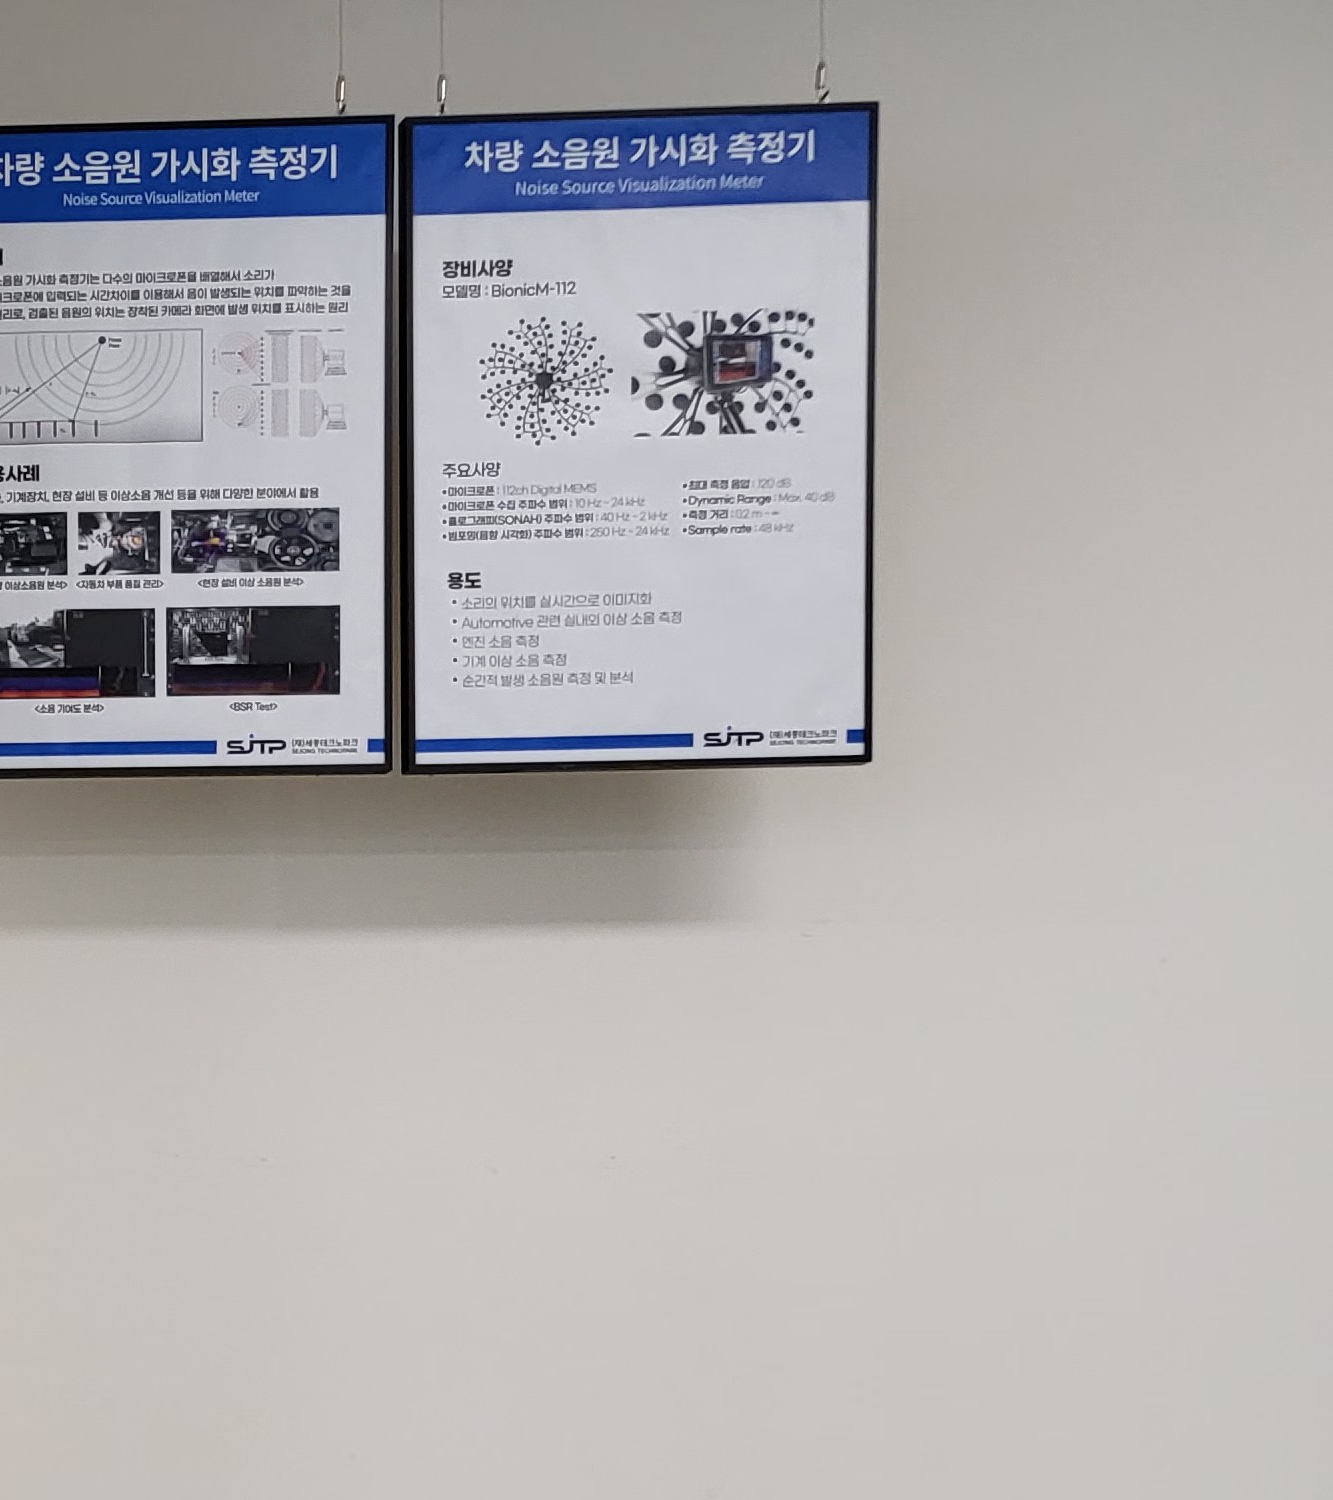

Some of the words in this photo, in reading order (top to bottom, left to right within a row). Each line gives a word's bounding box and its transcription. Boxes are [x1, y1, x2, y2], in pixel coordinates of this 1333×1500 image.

[464, 140, 523, 173] 차량
[531, 137, 621, 170] 소음원
[630, 133, 719, 168] 가시화
[727, 130, 816, 165] 측정기
[53, 149, 141, 185] 소음원
[150, 146, 241, 183] 가시화
[249, 144, 337, 180] 측정기
[515, 181, 559, 197] Noise
[562, 178, 615, 195] Source
[619, 175, 716, 194] Visualization
[720, 174, 765, 190] Meter
[63, 193, 97, 207] Noise
[100, 192, 142, 206] Source
[144, 189, 221, 205] Visualization
[224, 188, 260, 203] Meter
[26, 274, 56, 286] 가시화
[59, 273, 100, 285] 측정기는
[102, 272, 133, 285] 다수의
[136, 271, 196, 283] 마이크로폰을
[200, 270, 240, 283] 배열해서
[243, 269, 274, 282] 소리가
[442, 259, 513, 279] 장비사양
[46, 291, 87, 303] 입력되는
[90, 290, 140, 302] 시간차이를
[143, 288, 184, 301] 이용해서
[254, 286, 284, 298] 위치를
[287, 285, 328, 297] 파악하는
[442, 284, 482, 300] 모델명
[491, 281, 576, 297] BionicM-112
[95, 306, 125, 318] 위치는
[128, 305, 159, 318] 장착된
[161, 304, 191, 317] 카메라
[195, 304, 225, 316] 화면에
[252, 303, 282, 315] 위치를
[285, 302, 325, 314] 표시하는
[442, 462, 501, 478] 주요사양
[52, 491, 72, 502] 현장
[75, 490, 95, 501] 설비
[154, 489, 173, 501] 개선
[200, 488, 220, 500] 위해
[223, 488, 253, 499] 다양한
[257, 487, 296, 499] 분야에서
[448, 486, 495, 496] 마이크로폰
[448, 501, 495, 511] 마이크로폰
[688, 494, 733, 507] Dynamic
[688, 525, 728, 536] Sample
[447, 572, 482, 589] 용도
[462, 597, 497, 610] 소리의
[540, 595, 600, 608] 실시간으로
[603, 592, 652, 606] 이미지화
[462, 616, 534, 629] Automotive
[537, 615, 561, 628] 관련
[604, 613, 627, 626] 이상
[631, 612, 655, 625] 소음
[659, 611, 682, 624] 측정
[462, 636, 485, 649] 엔진
[489, 635, 512, 648] 소음
[516, 635, 540, 648] 측정
[463, 655, 486, 668] 기계
[489, 655, 512, 667] 이상
[516, 654, 539, 667] 소음
[543, 654, 567, 667] 측정
[463, 675, 498, 688] 순간적
[528, 674, 564, 687] 소음원
[567, 673, 591, 685] 측정
[610, 671, 633, 684] 분석
